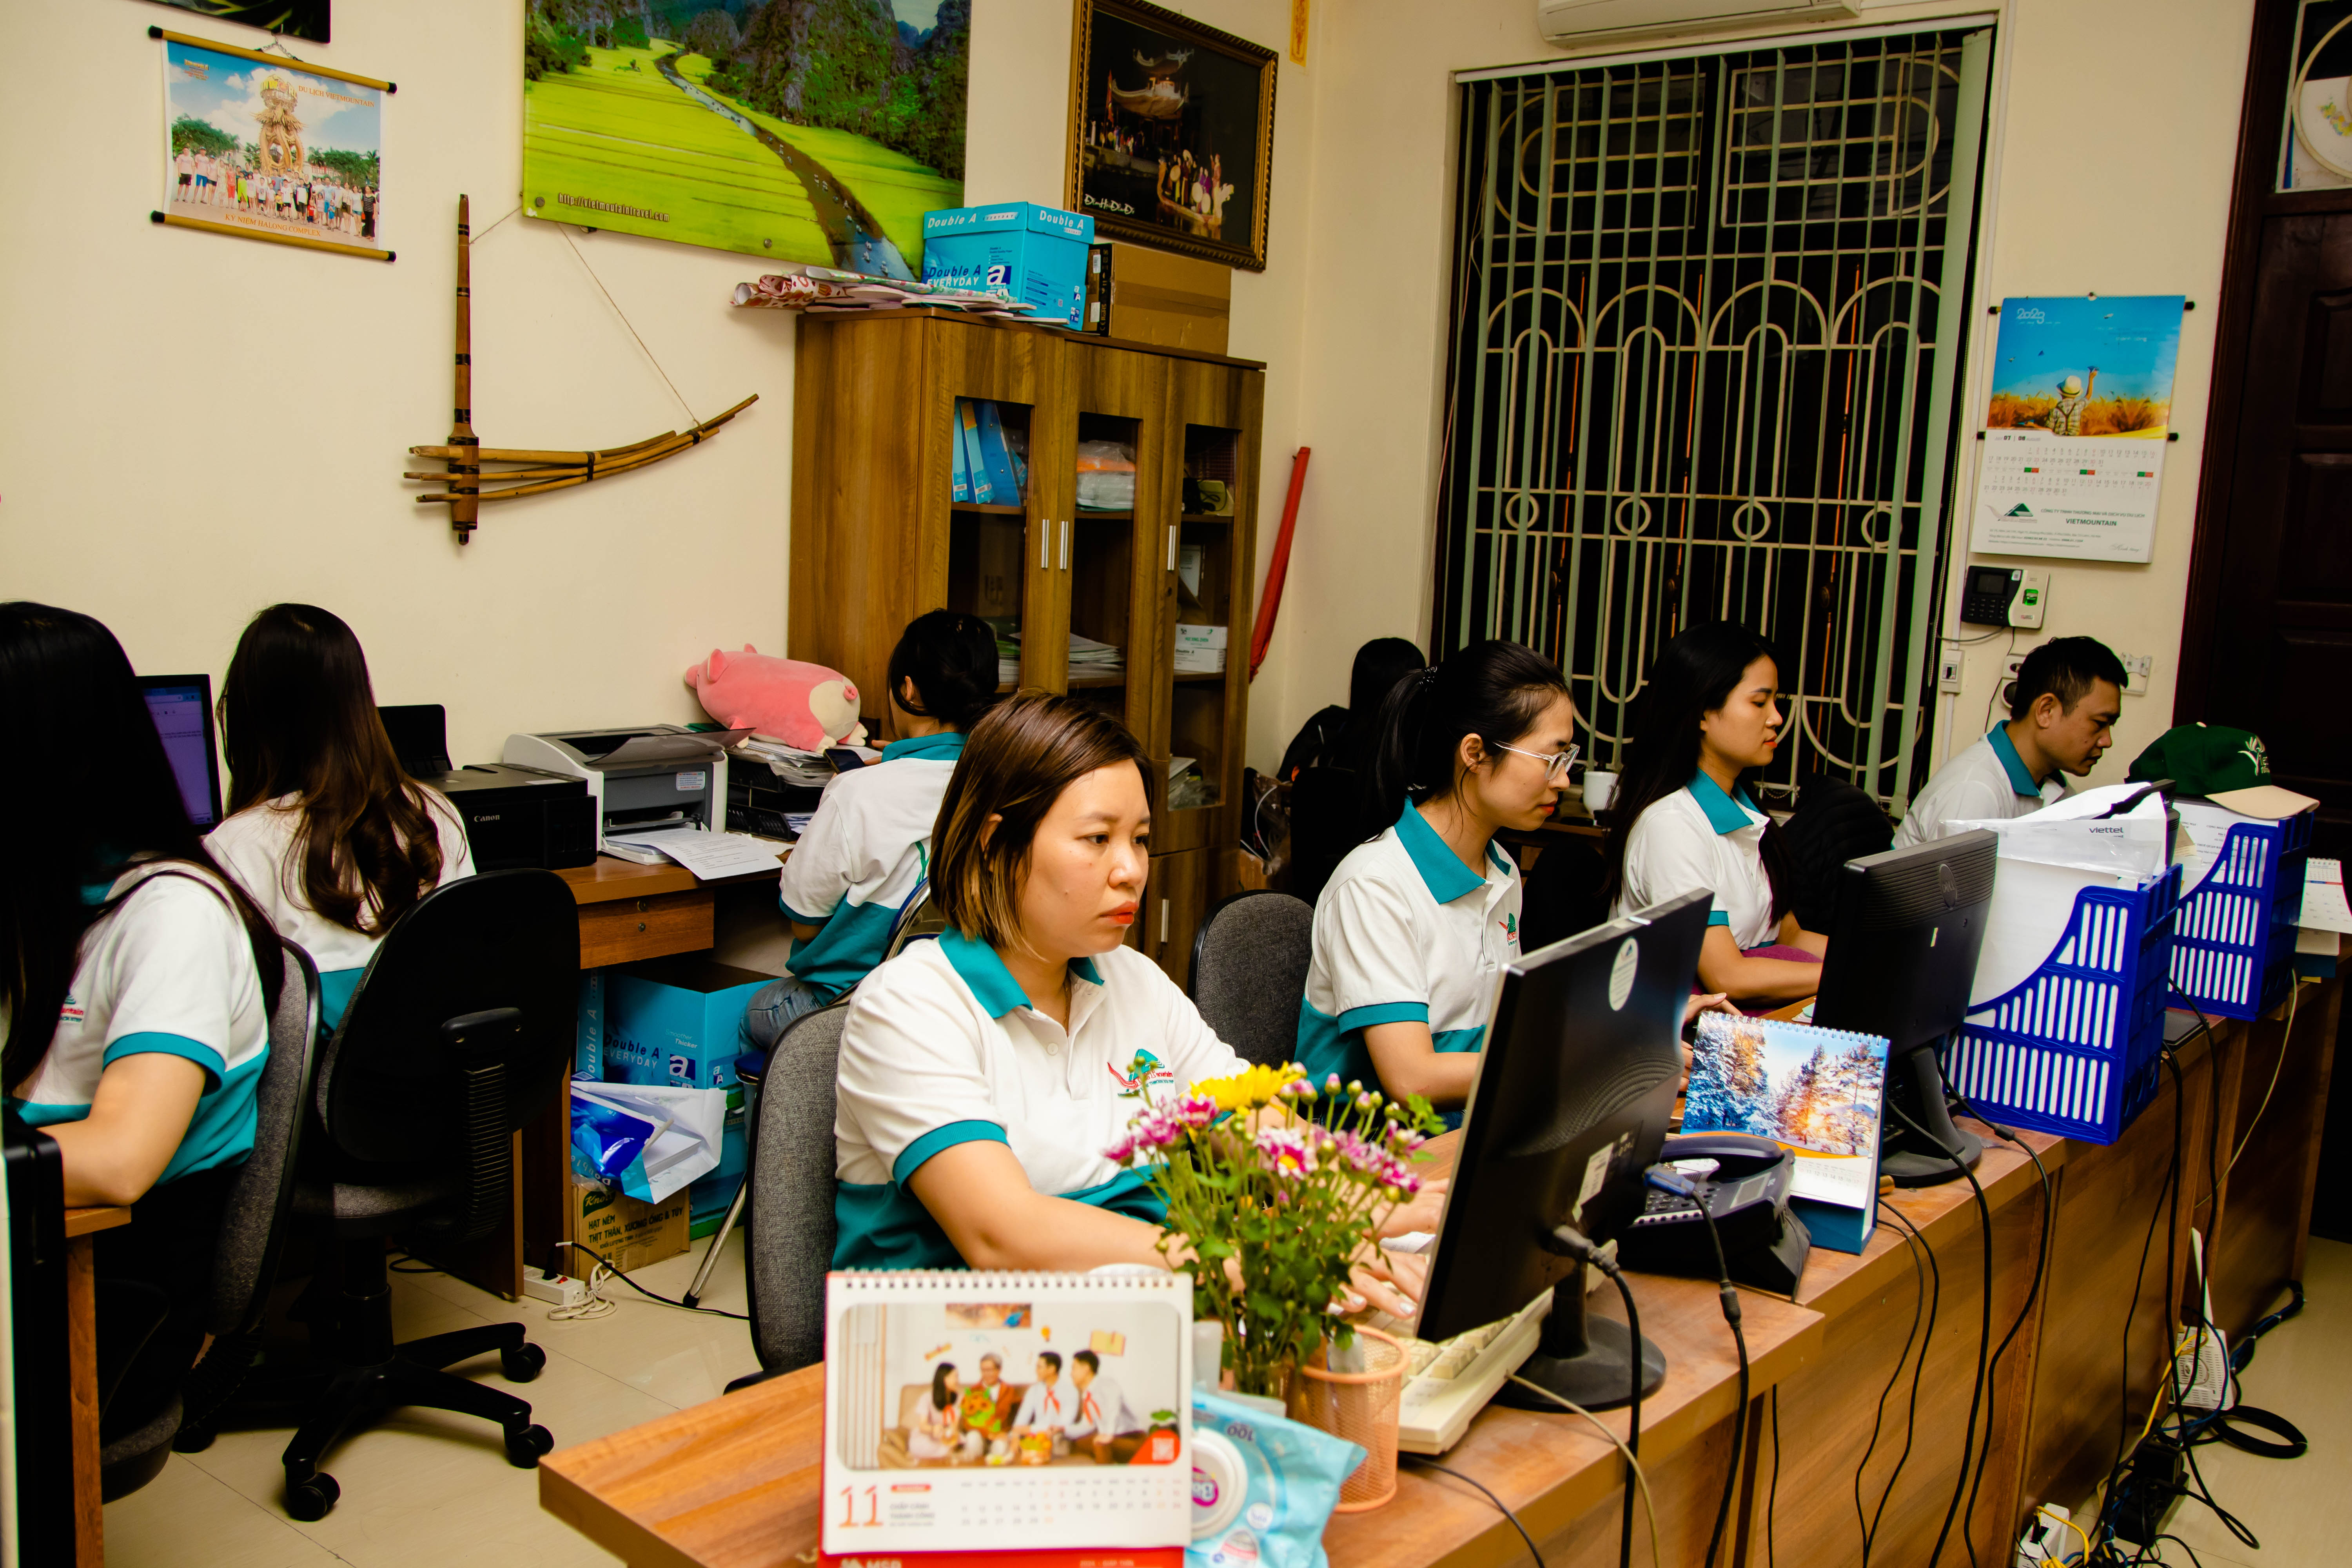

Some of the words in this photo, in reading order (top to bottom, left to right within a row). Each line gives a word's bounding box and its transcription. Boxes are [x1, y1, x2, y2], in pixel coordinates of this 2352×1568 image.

[325, 92, 375, 107] VIETMOUNTAIN
[559, 192, 670, 222] http://vietmoutaintravel.com
[928, 215, 965, 229] Double
[968, 213, 976, 223] A
[1040, 210, 1074, 227] Double
[1077, 219, 1083, 229] A
[258, 219, 287, 231] HALONG
[289, 226, 321, 236] COMPLEX
[929, 265, 969, 278] Double
[973, 264, 981, 276] A
[927, 276, 979, 287] EVERYDAY
[2065, 518, 2117, 526] VIETMOUNTAIN
[587, 1009, 597, 1020] A
[665, 1029, 693, 1040] Smoother
[586, 1027, 597, 1073] ouble
[603, 1034, 646, 1056] Double
[651, 1047, 659, 1060] A
[675, 1038, 698, 1049] Thicker
[603, 1047, 658, 1069] EVERYDAY
[589, 1218, 600, 1230] HẠT
[589, 1232, 602, 1244] THỊT
[838, 1485, 884, 1528] 11
